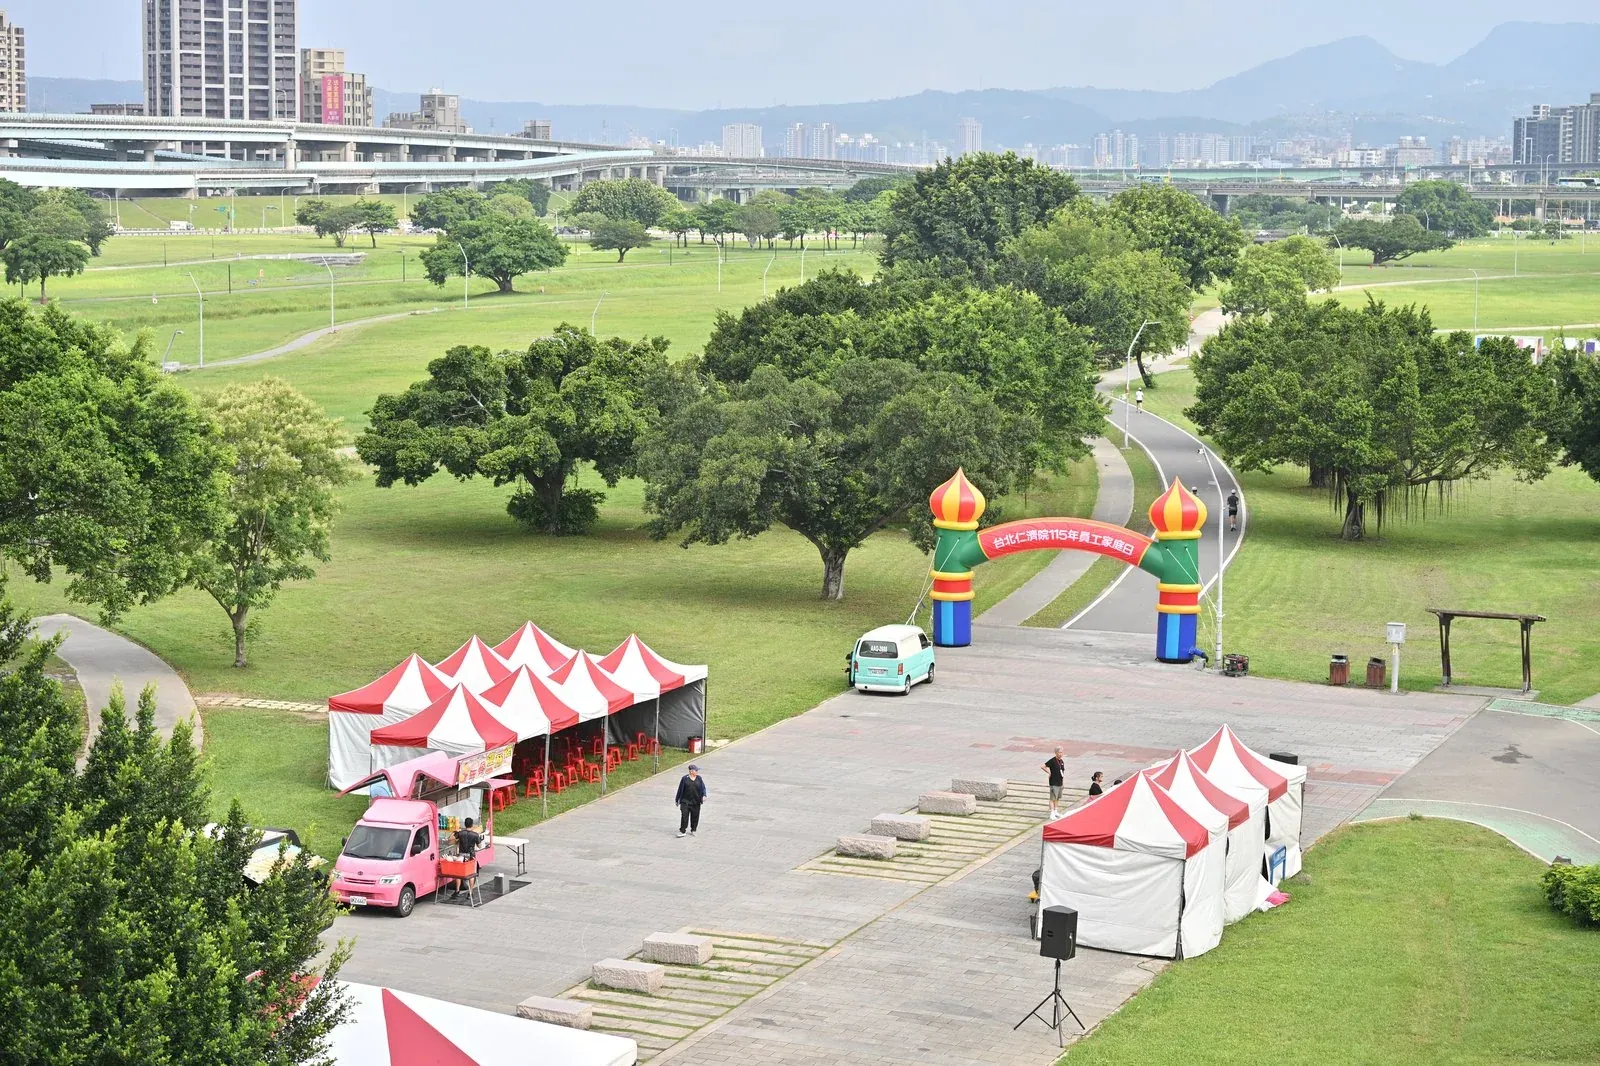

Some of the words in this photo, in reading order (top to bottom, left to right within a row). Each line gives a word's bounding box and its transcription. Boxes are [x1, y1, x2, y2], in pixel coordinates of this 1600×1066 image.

[992, 529, 1135, 556] 台北仁濟院115年員工家庭日
